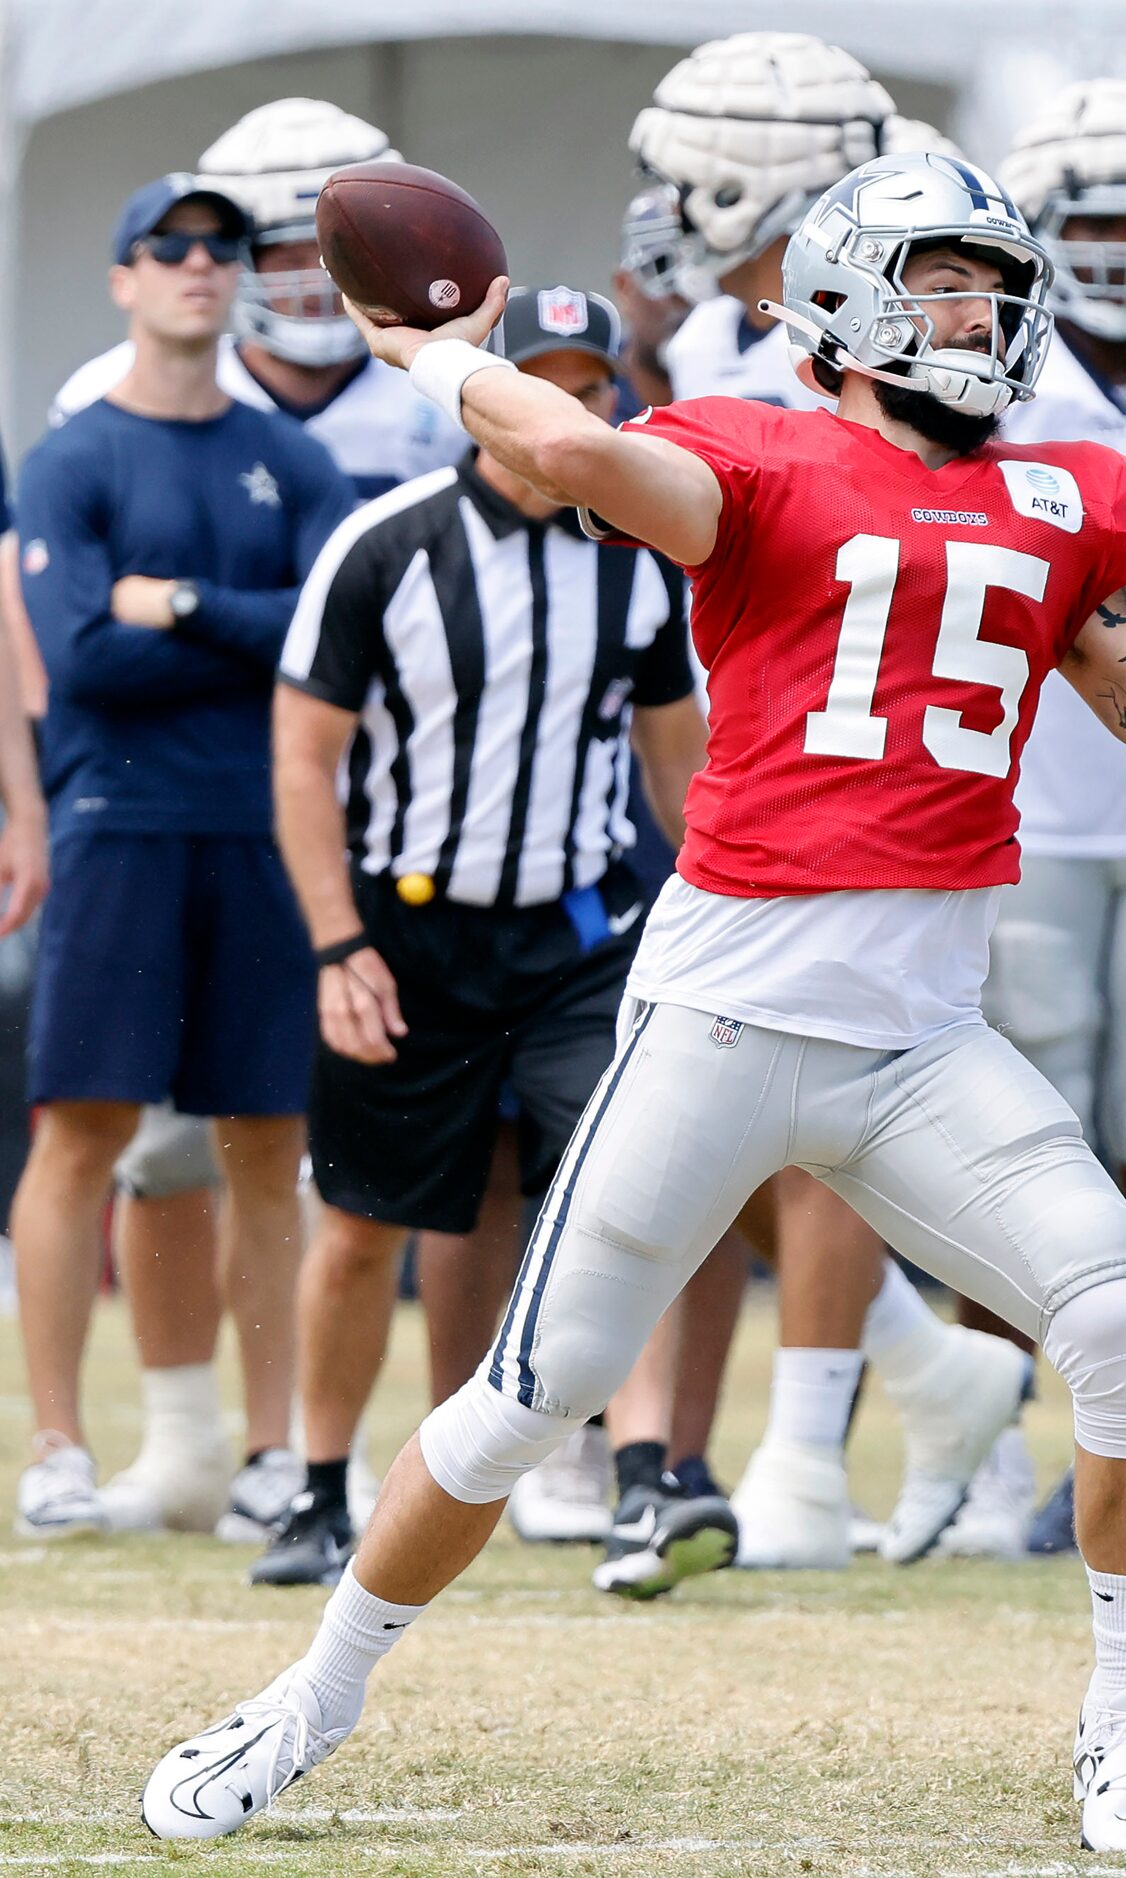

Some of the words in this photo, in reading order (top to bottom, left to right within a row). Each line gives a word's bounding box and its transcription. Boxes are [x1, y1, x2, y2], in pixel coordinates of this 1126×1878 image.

[912, 508, 987, 526] COWBOYS
[1031, 497, 1068, 518] AT&T
[803, 533, 1050, 779] 15
[714, 1024, 734, 1043] NFL
